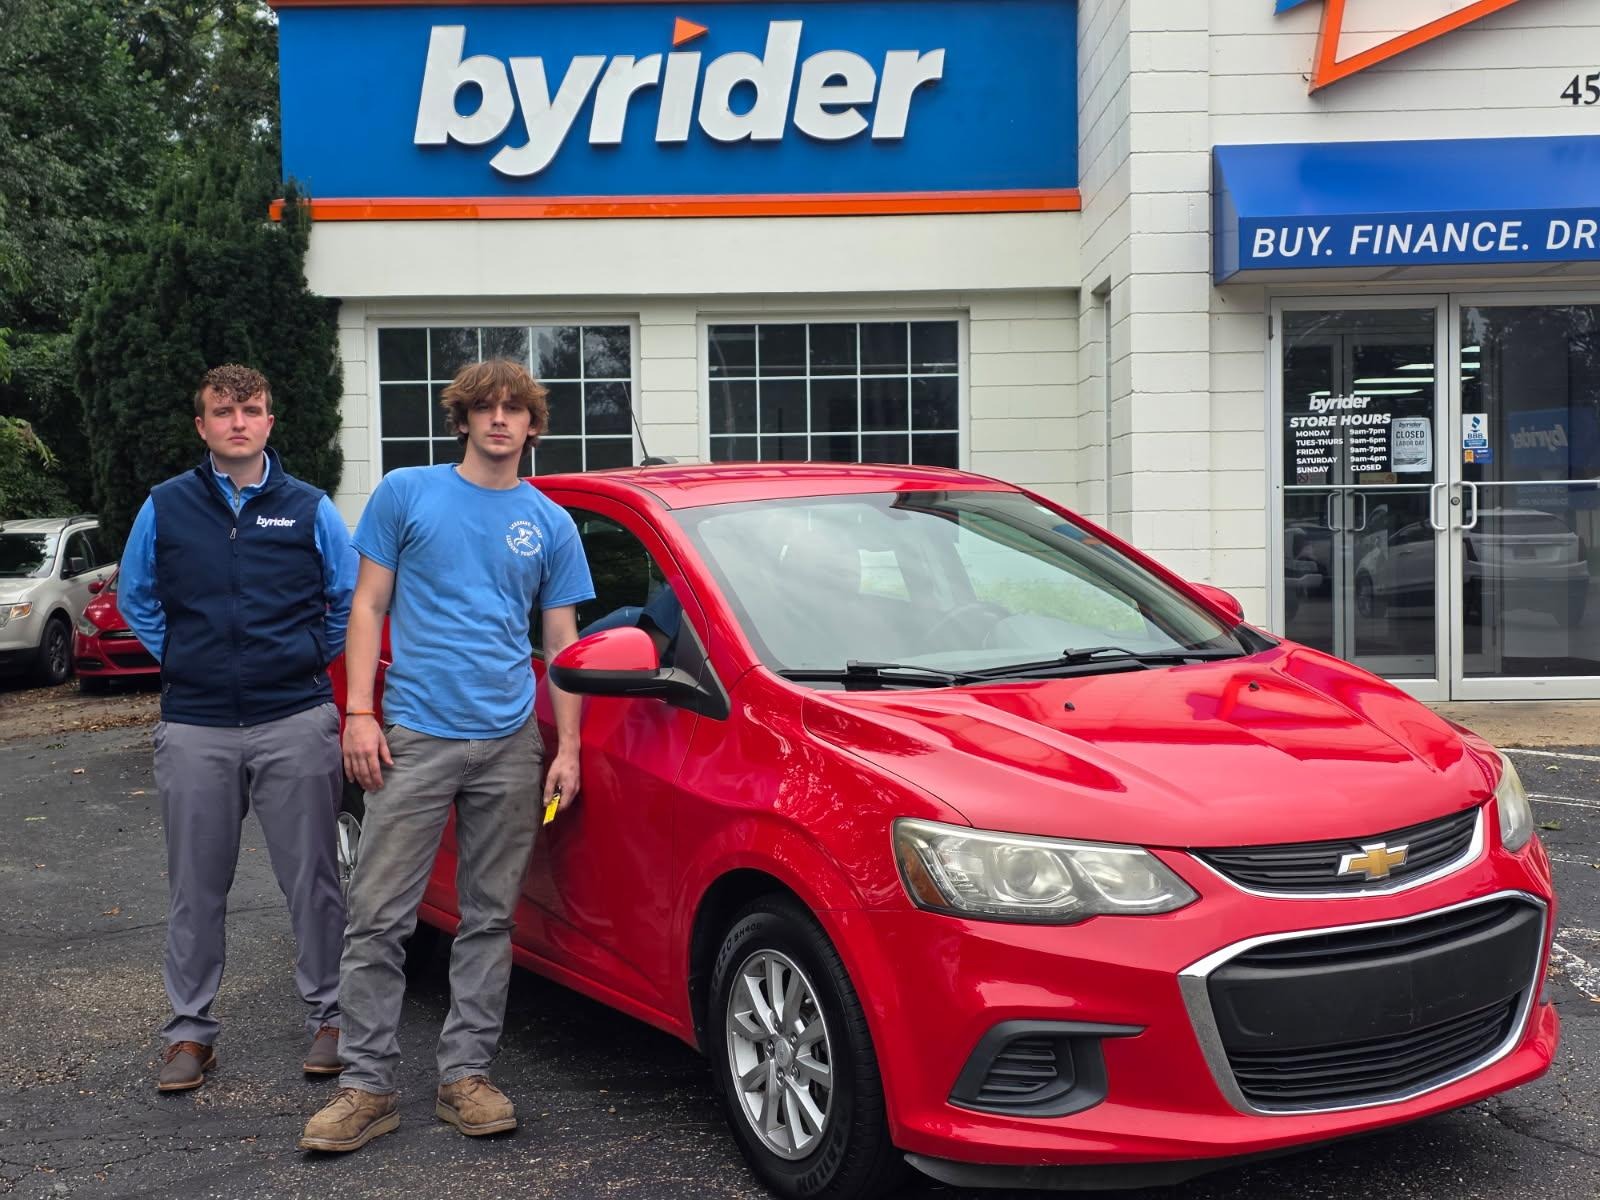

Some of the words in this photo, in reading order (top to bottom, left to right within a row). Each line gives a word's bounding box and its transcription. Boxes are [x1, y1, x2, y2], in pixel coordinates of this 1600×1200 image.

[1560, 72, 1600, 105] 45
[414, 17, 945, 176] byrider
[1252, 226, 1332, 258] BUY.
[1349, 221, 1529, 255] FINANCE.
[1309, 394, 1371, 413] byrider
[1290, 415, 1338, 428] STORE
[1340, 413, 1391, 426] HOURS
[1349, 427, 1386, 435] 9am-7pm
[1396, 430, 1425, 439] CLOSED
[1296, 438, 1343, 446] TUES-THURS
[1349, 445, 1386, 453] 9am-7pm
[1296, 456, 1338, 465] SATURDAY
[1350, 454, 1387, 463] 9am-4pm
[1297, 466, 1329, 474] SUNDAY
[256, 515, 296, 528] byrider
